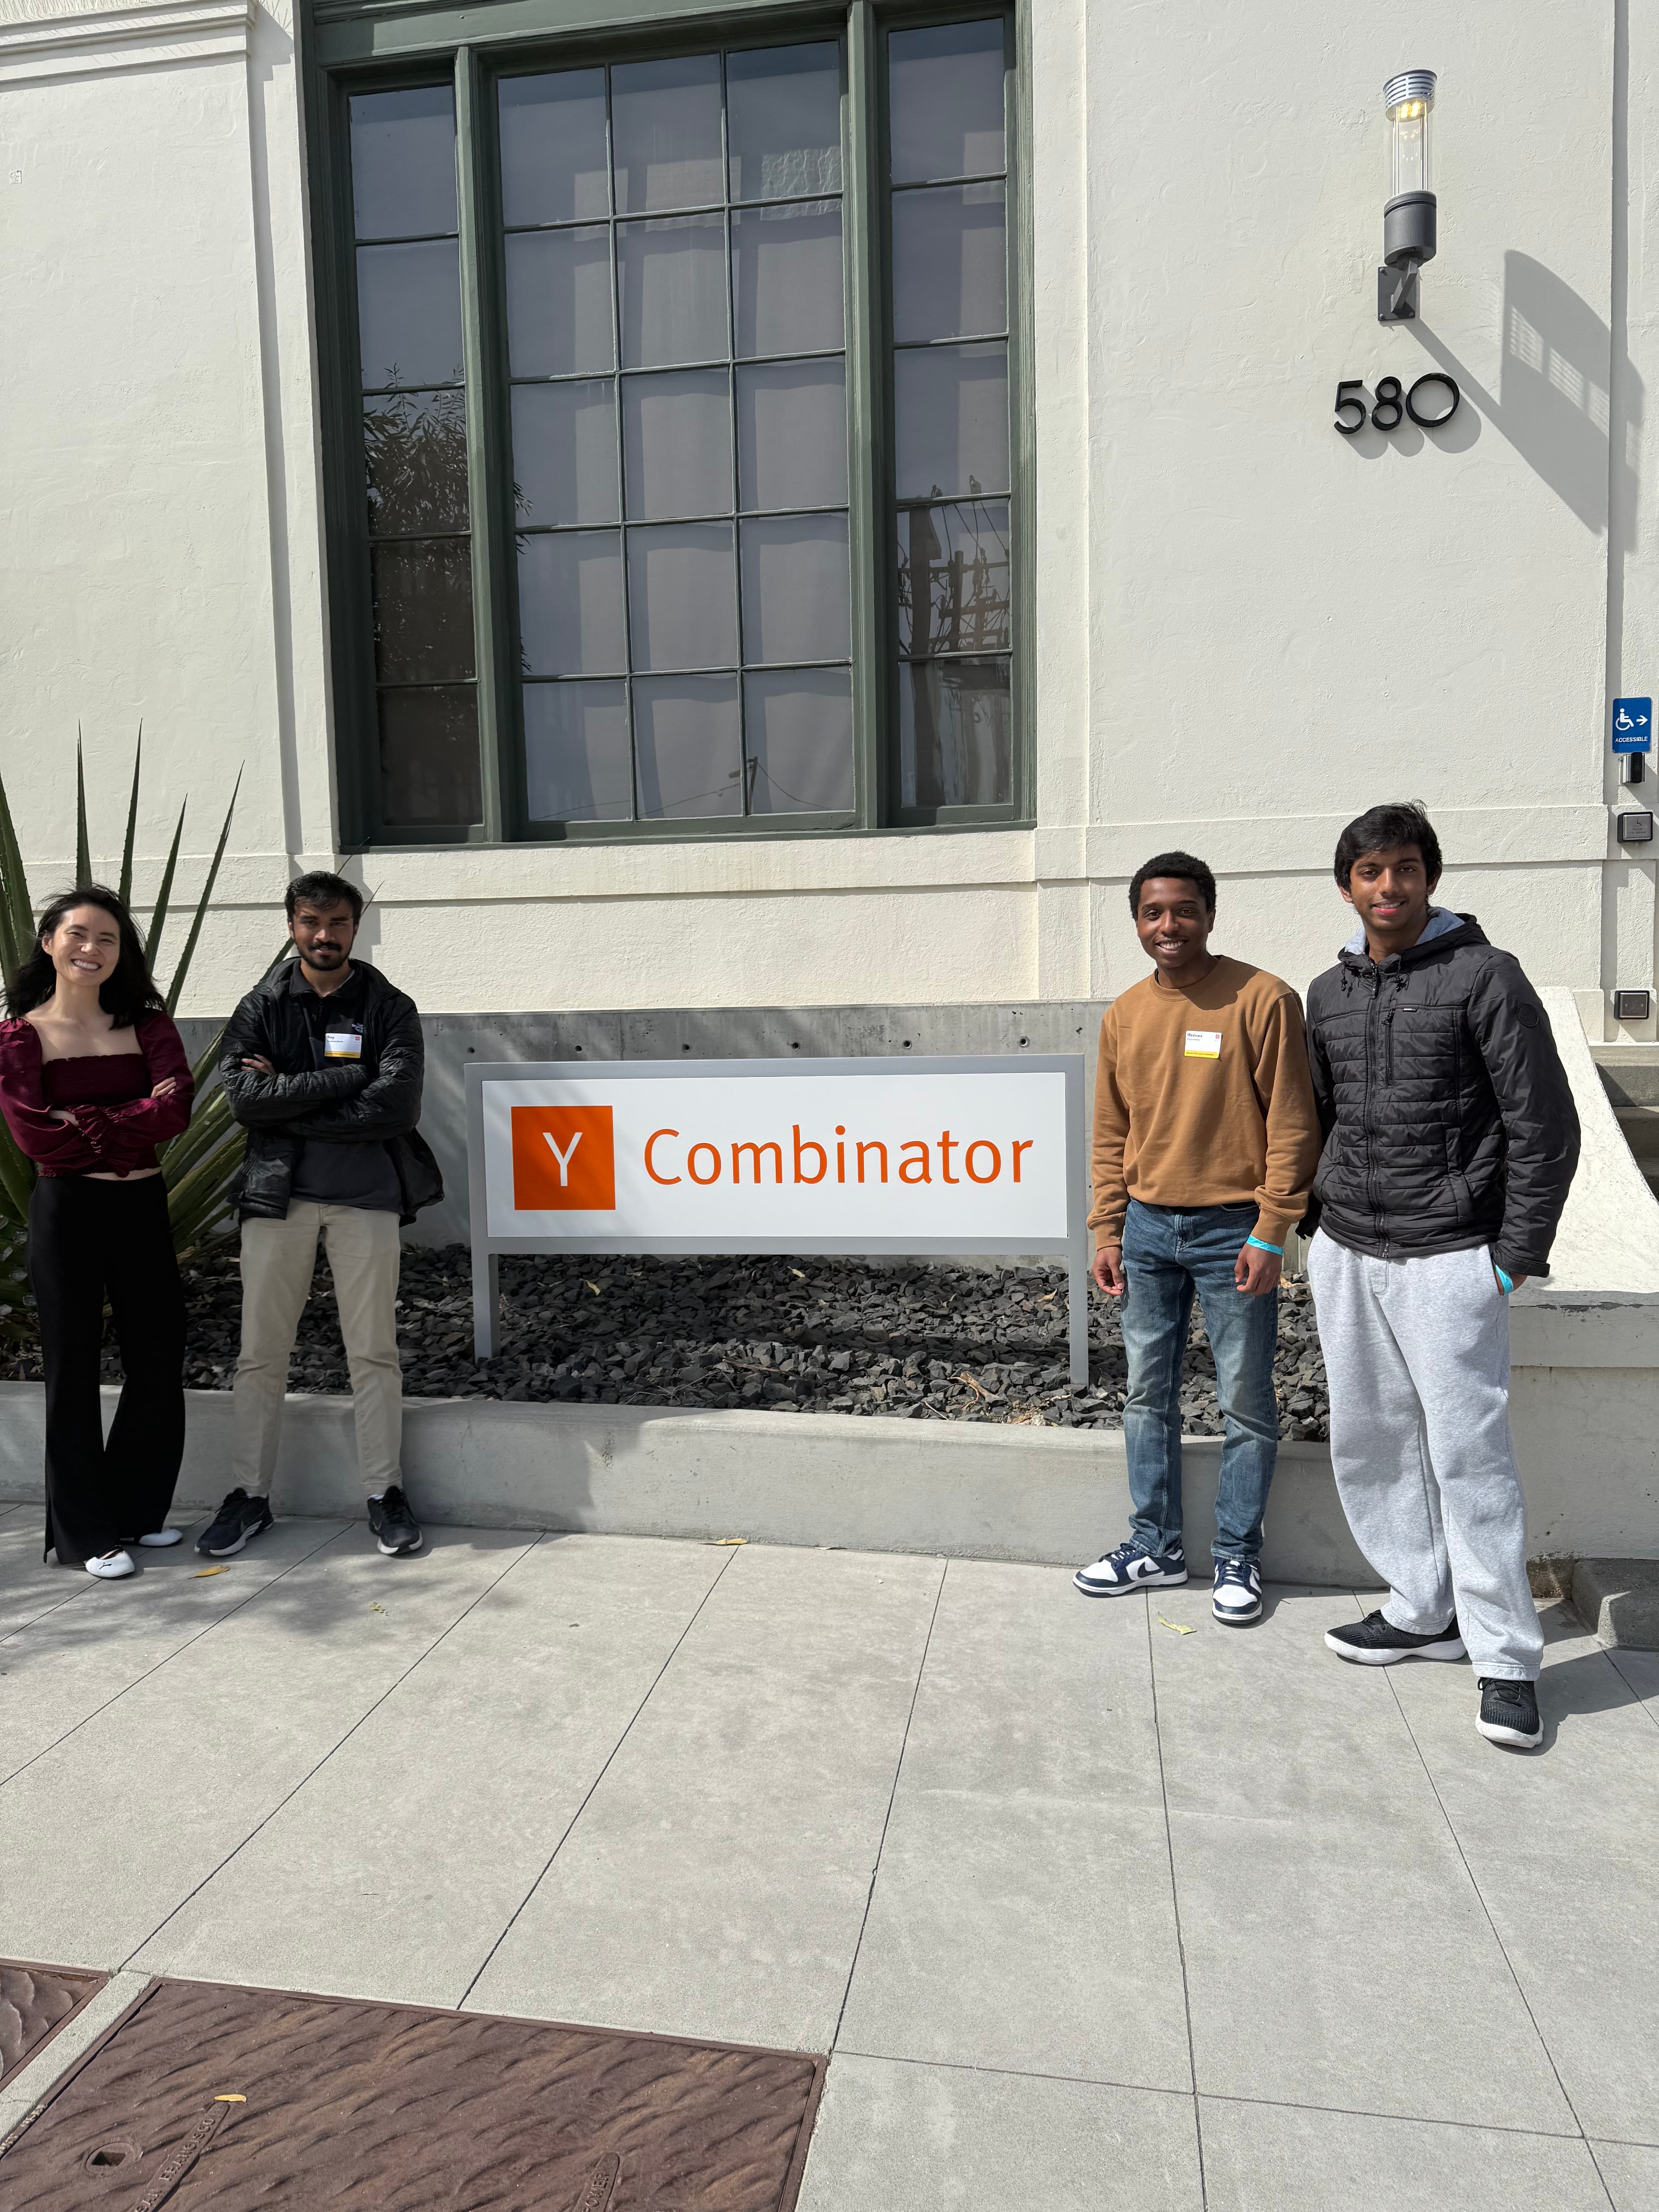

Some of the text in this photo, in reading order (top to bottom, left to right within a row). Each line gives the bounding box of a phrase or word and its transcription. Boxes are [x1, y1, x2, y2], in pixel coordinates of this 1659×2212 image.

[1334, 372, 1460, 434] 580
[542, 1125, 1034, 1186] Y Combinator
[159, 2119, 216, 2181] FRANCISCO
